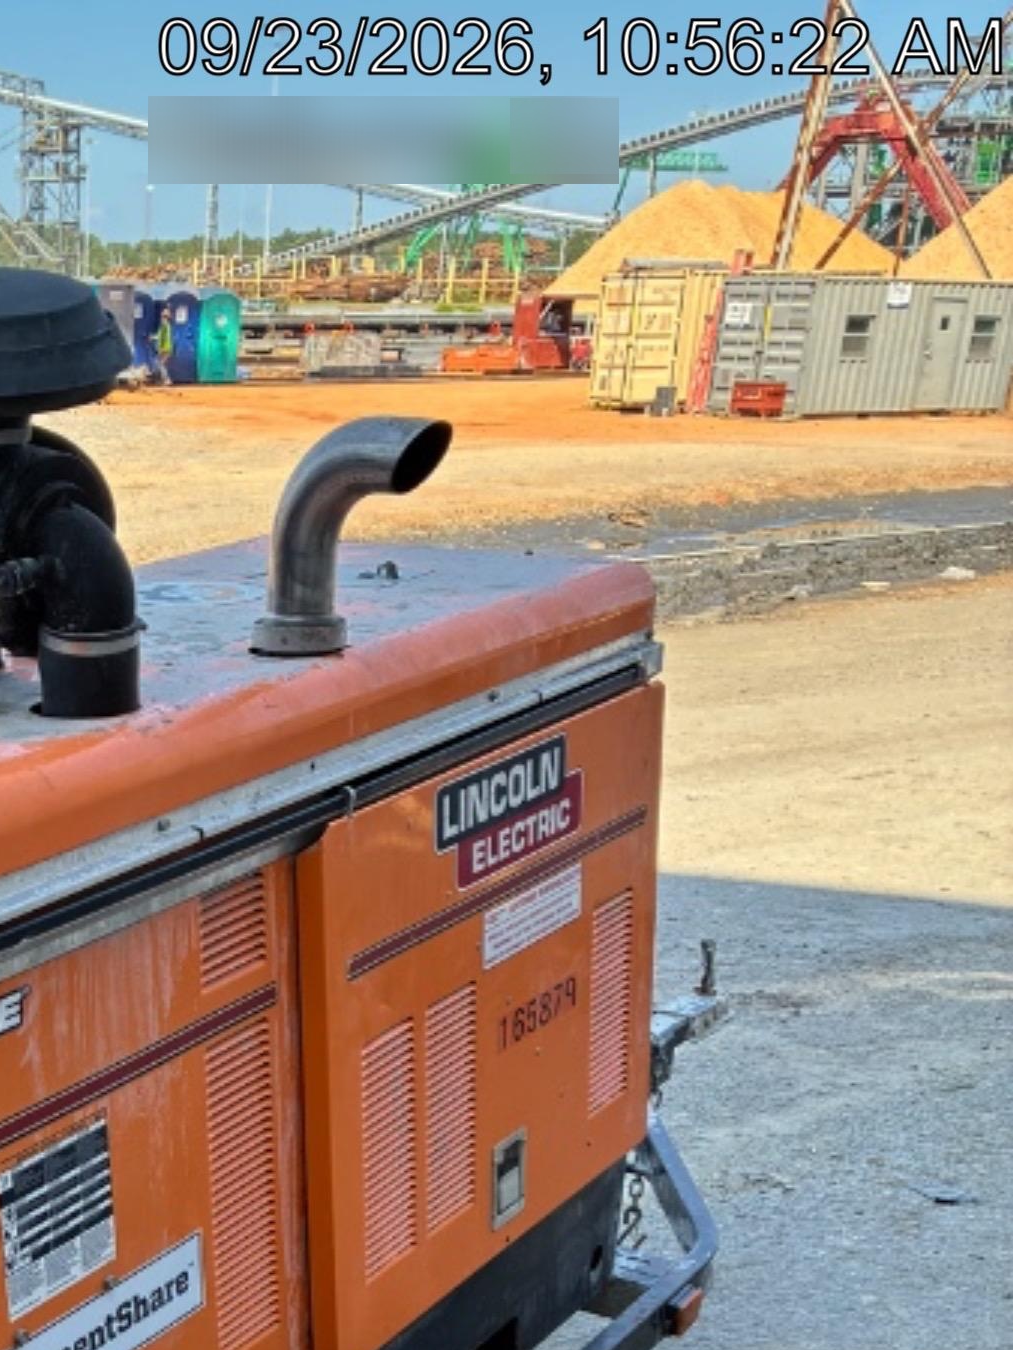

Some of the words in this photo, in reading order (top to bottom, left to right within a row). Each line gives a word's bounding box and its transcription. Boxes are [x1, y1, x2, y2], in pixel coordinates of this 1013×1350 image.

[441, 746, 562, 841] LINCOLN
[471, 797, 571, 874] ELECTRIC
[498, 976, 577, 1050] 165879
